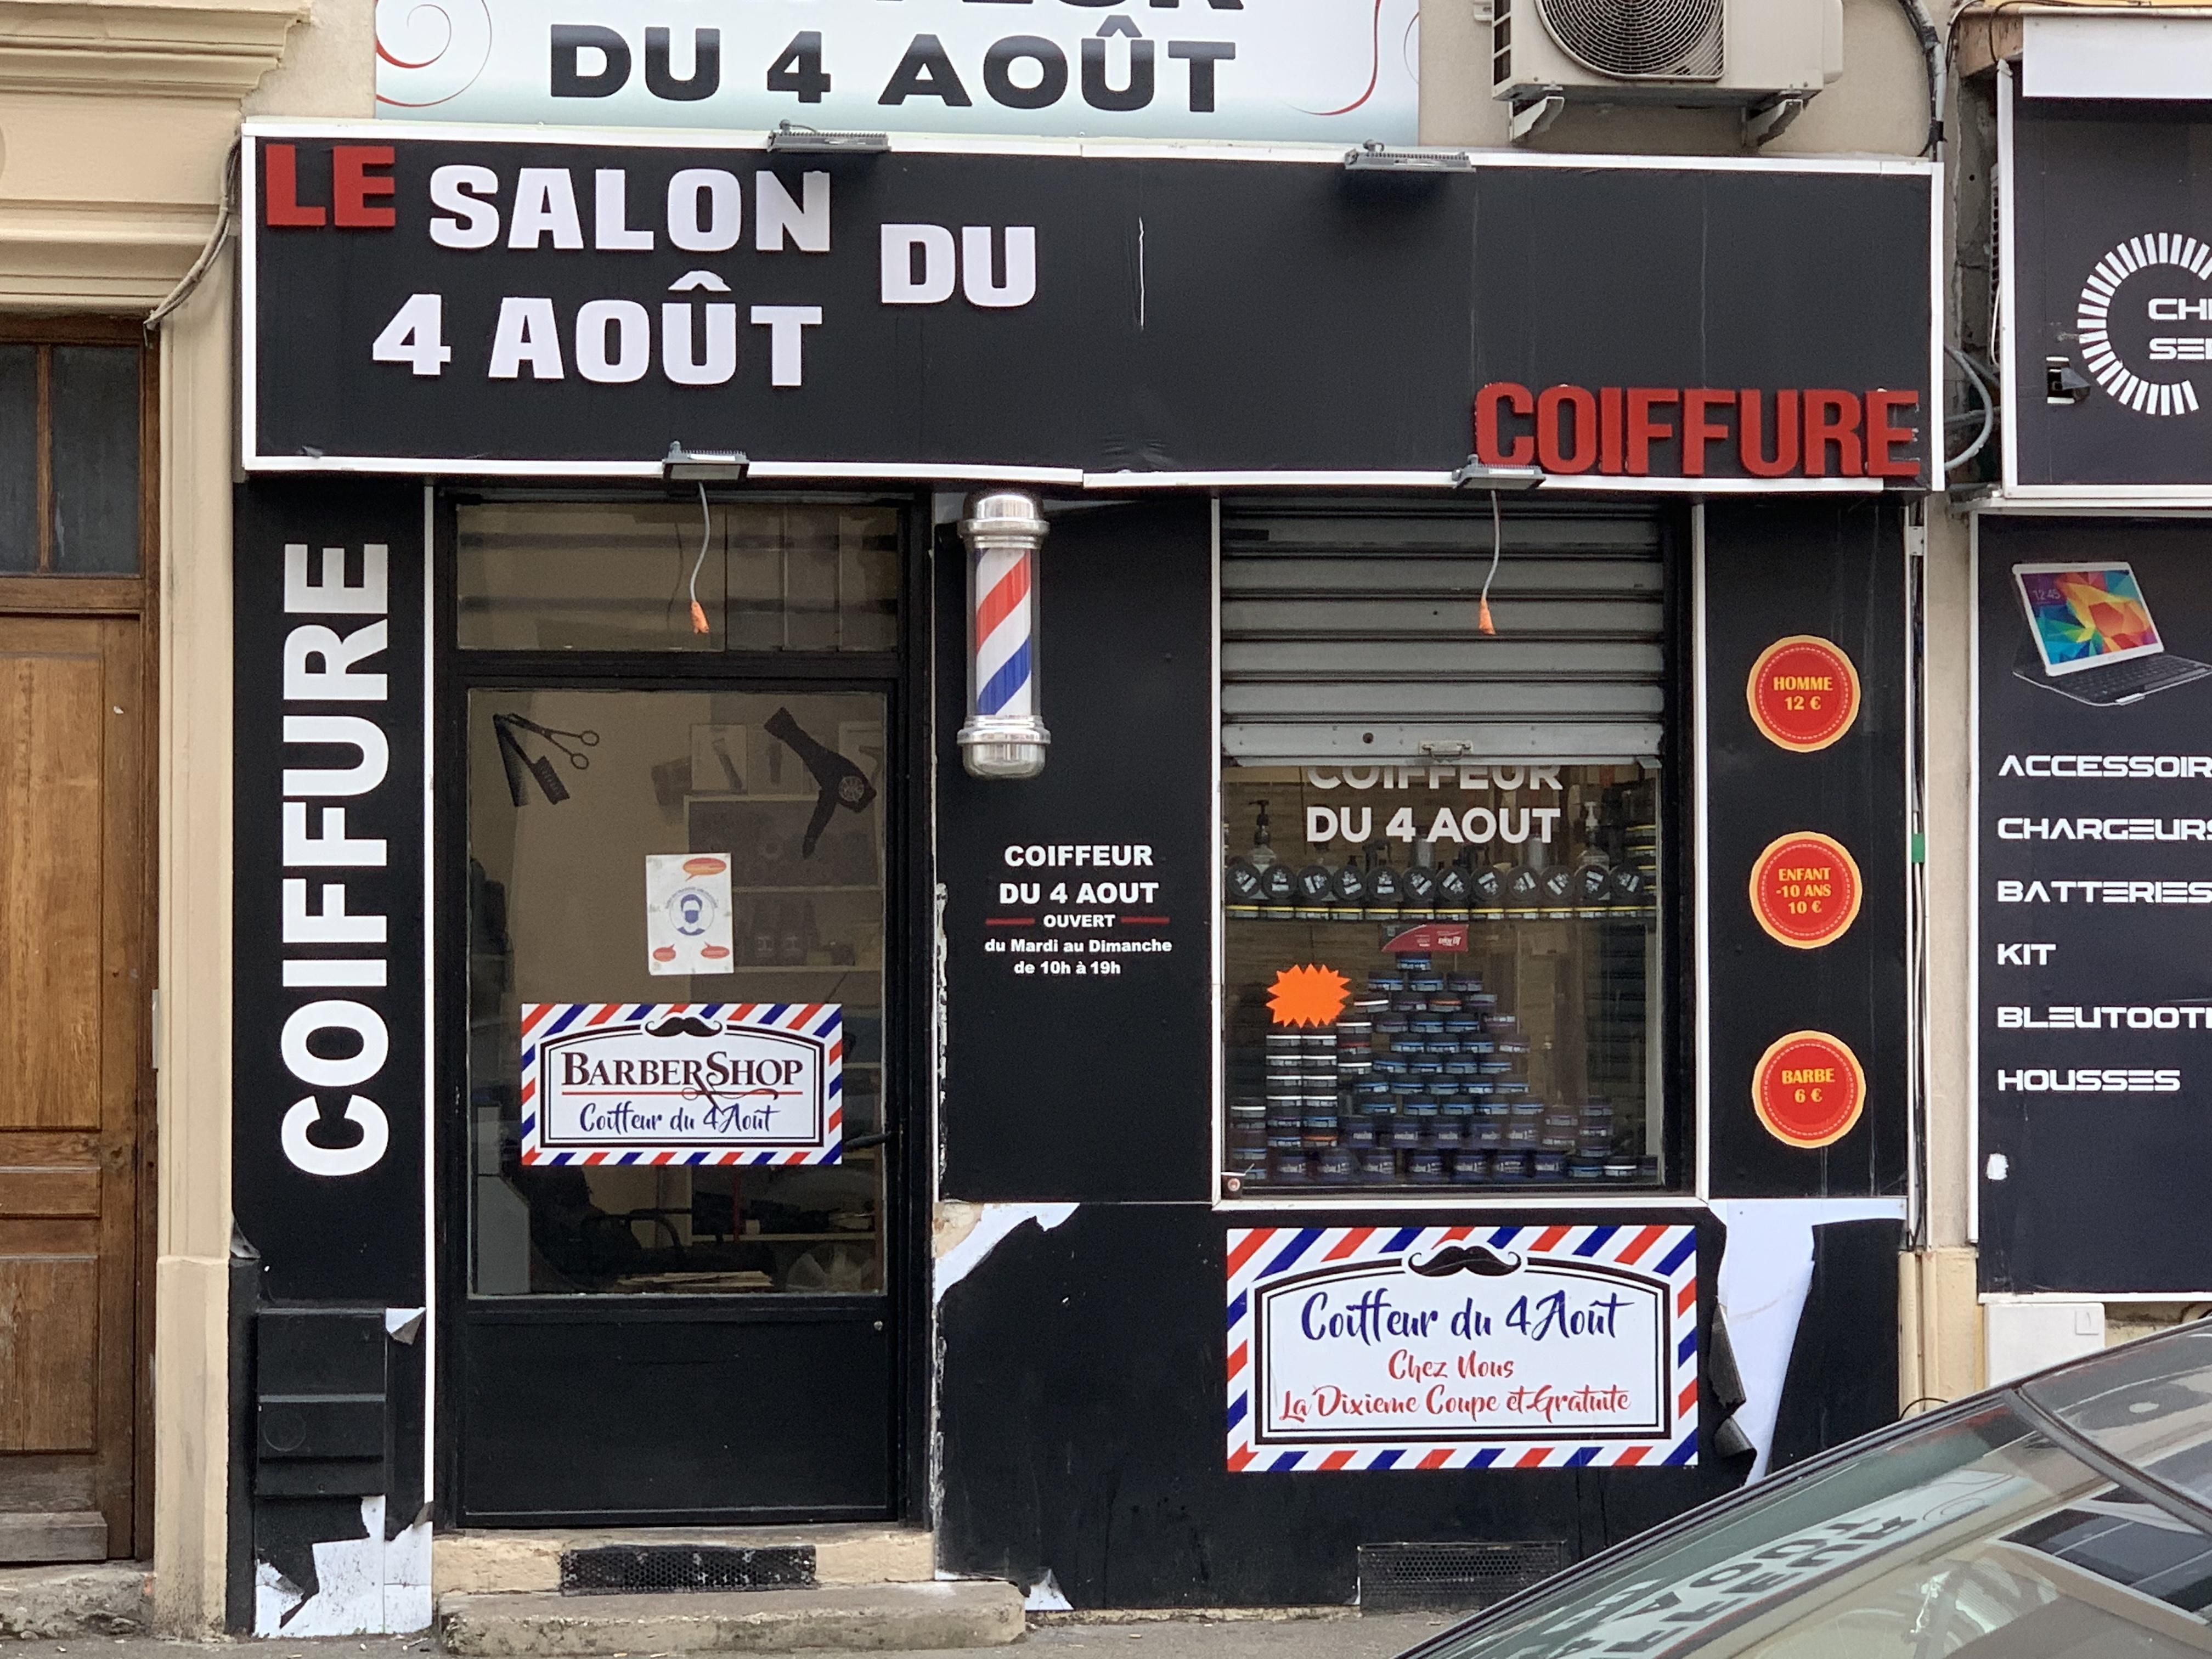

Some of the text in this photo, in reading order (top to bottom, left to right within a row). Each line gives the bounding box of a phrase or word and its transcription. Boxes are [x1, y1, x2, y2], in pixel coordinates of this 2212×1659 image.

[551, 15, 1236, 112] DU 4 AOÛT
[264, 144, 1037, 307] LE SALON DU
[2148, 298, 2212, 320] CH
[371, 270, 823, 386] 4 AOÛT
[2149, 337, 2212, 359] SE
[1475, 382, 1920, 477] COIFFURE
[1773, 676, 1833, 691] HOMME
[1785, 696, 1821, 710] 12 €
[1307, 806, 1561, 844] DU 4 AOUT
[1997, 818, 2212, 840] CHARGEUR
[281, 543, 389, 1176] COIFFURE
[1005, 845, 1154, 866] COIFFEUR
[1779, 867, 1831, 881] ENFANT
[1000, 883, 1159, 904] DU 4 AOUT
[1776, 884, 1831, 898] -10 ANS
[1997, 881, 2212, 903] BATTERIES
[1788, 900, 1822, 914] 10 €
[1043, 914, 1115, 928] OUVERT
[985, 939, 1172, 952] du Mardi au Dimanche
[1997, 943, 2057, 965] KIT
[1014, 961, 1121, 974] de 10h à 19h
[1997, 1007, 2212, 1029] BLEUTOOT
[1782, 1068, 1836, 1084] BARBE
[1997, 1069, 2181, 1092] HOUSSES
[1795, 1088, 1822, 1103] 6 €
[580, 1101, 662, 1135] Coiffeur
[670, 1107, 695, 1132] du
[703, 1105, 718, 1130] 4
[1301, 1288, 1438, 1346] Coiffeur
[1451, 1297, 1491, 1340] du
[1505, 1295, 1531, 1335] 4
[1389, 1349, 1514, 1383] Chez Nous
[1279, 1384, 1632, 1424] La Dixieme Coupe et Gratuite
